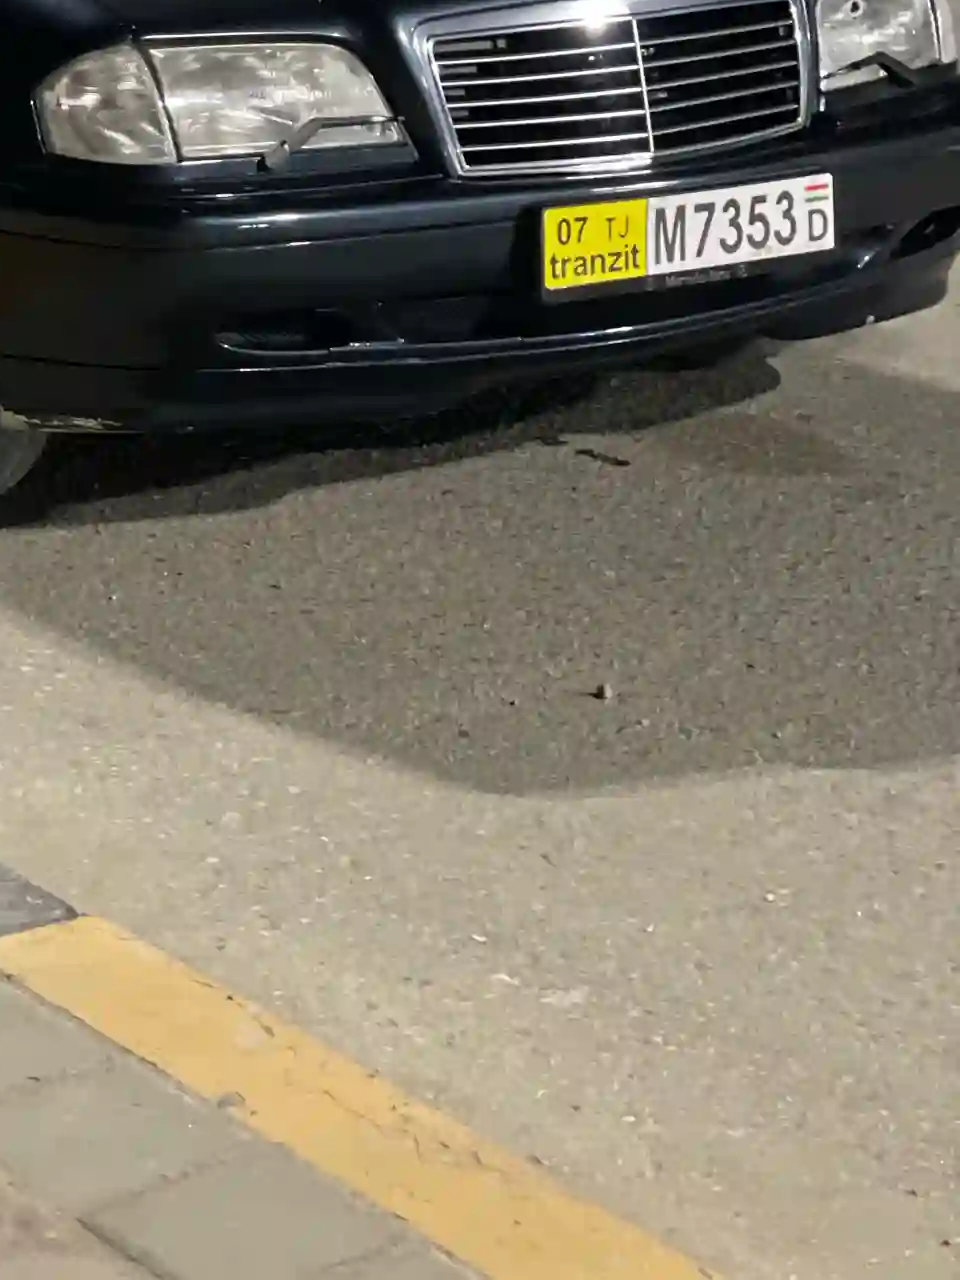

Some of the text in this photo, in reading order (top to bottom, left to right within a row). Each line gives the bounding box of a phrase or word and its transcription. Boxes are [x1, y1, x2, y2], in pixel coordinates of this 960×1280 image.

[557, 215, 630, 246] 07 TJ
[653, 190, 829, 266] M7353 D
[549, 244, 640, 280] tranzit
